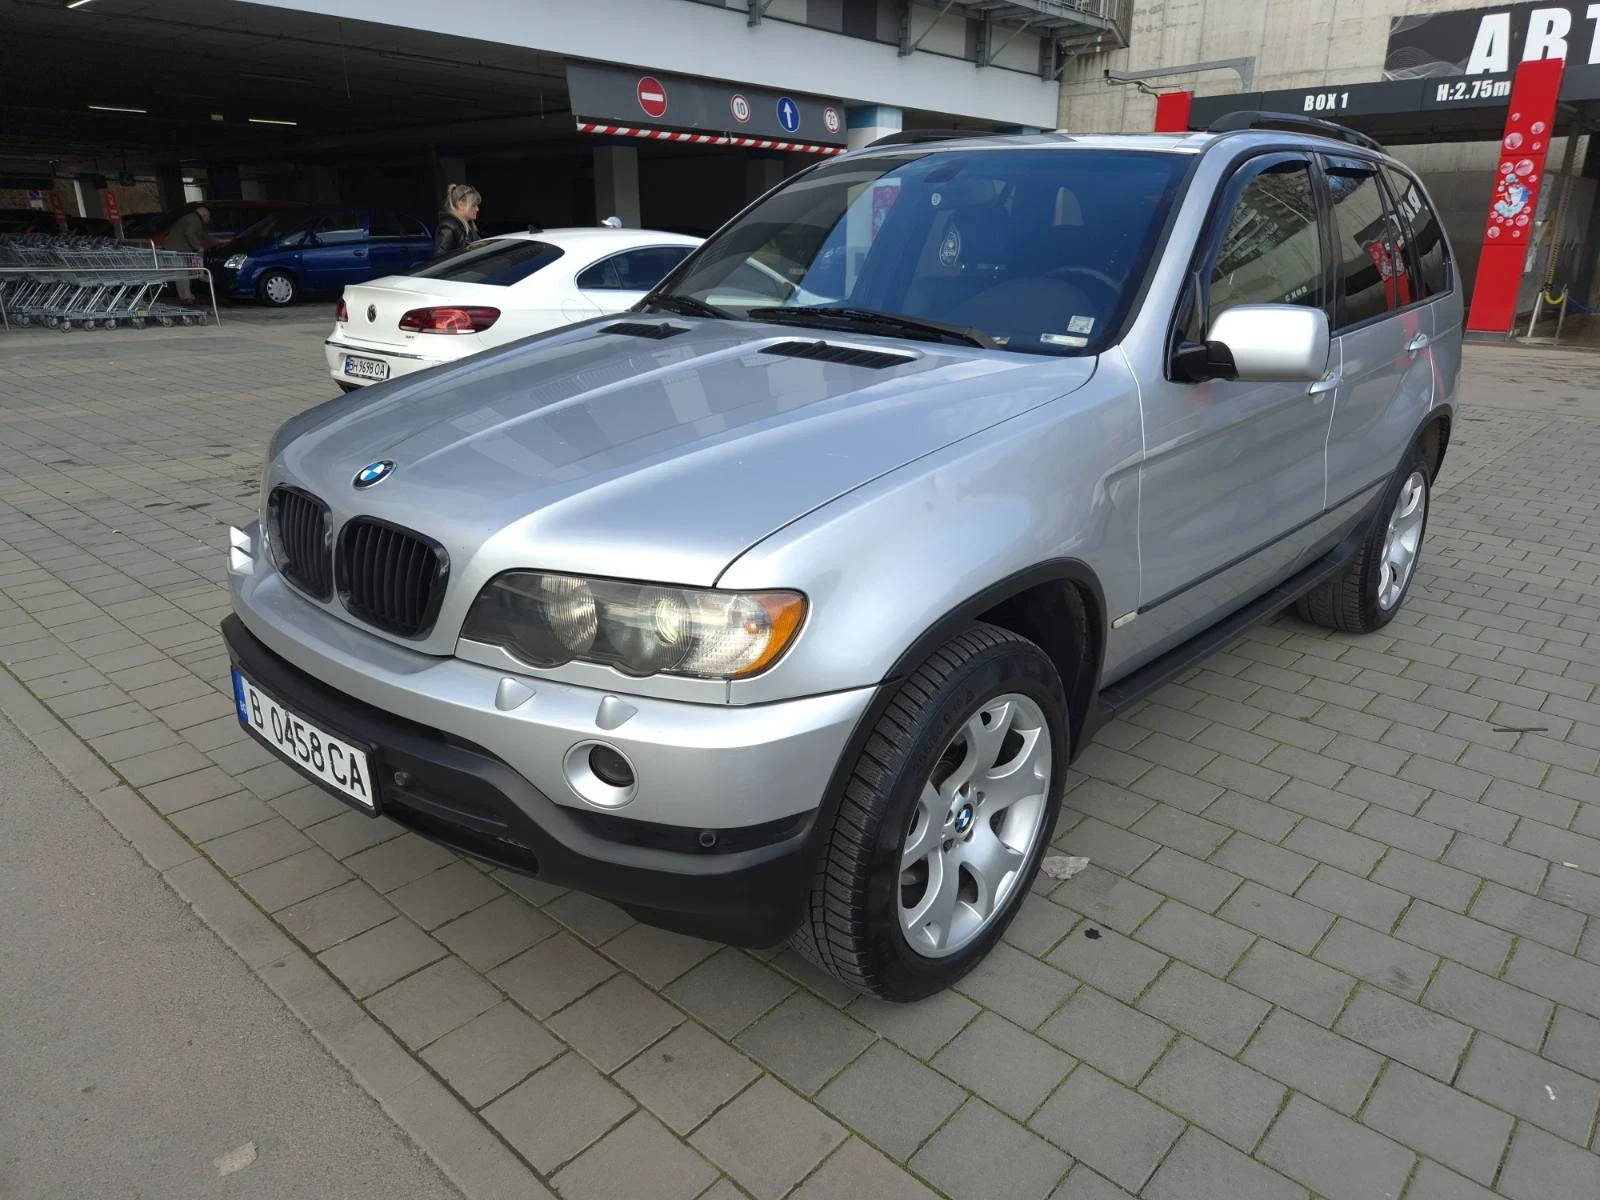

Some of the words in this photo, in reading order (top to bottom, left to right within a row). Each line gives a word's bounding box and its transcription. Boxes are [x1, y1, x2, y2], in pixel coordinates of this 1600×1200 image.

[1436, 78, 1511, 102] H:2.75m
[736, 101, 746, 116] 10
[1303, 93, 1336, 111] BOX
[1341, 92, 1349, 109] 1
[250, 689, 264, 730] B
[271, 706, 325, 772] 0458
[328, 743, 367, 797] CA
